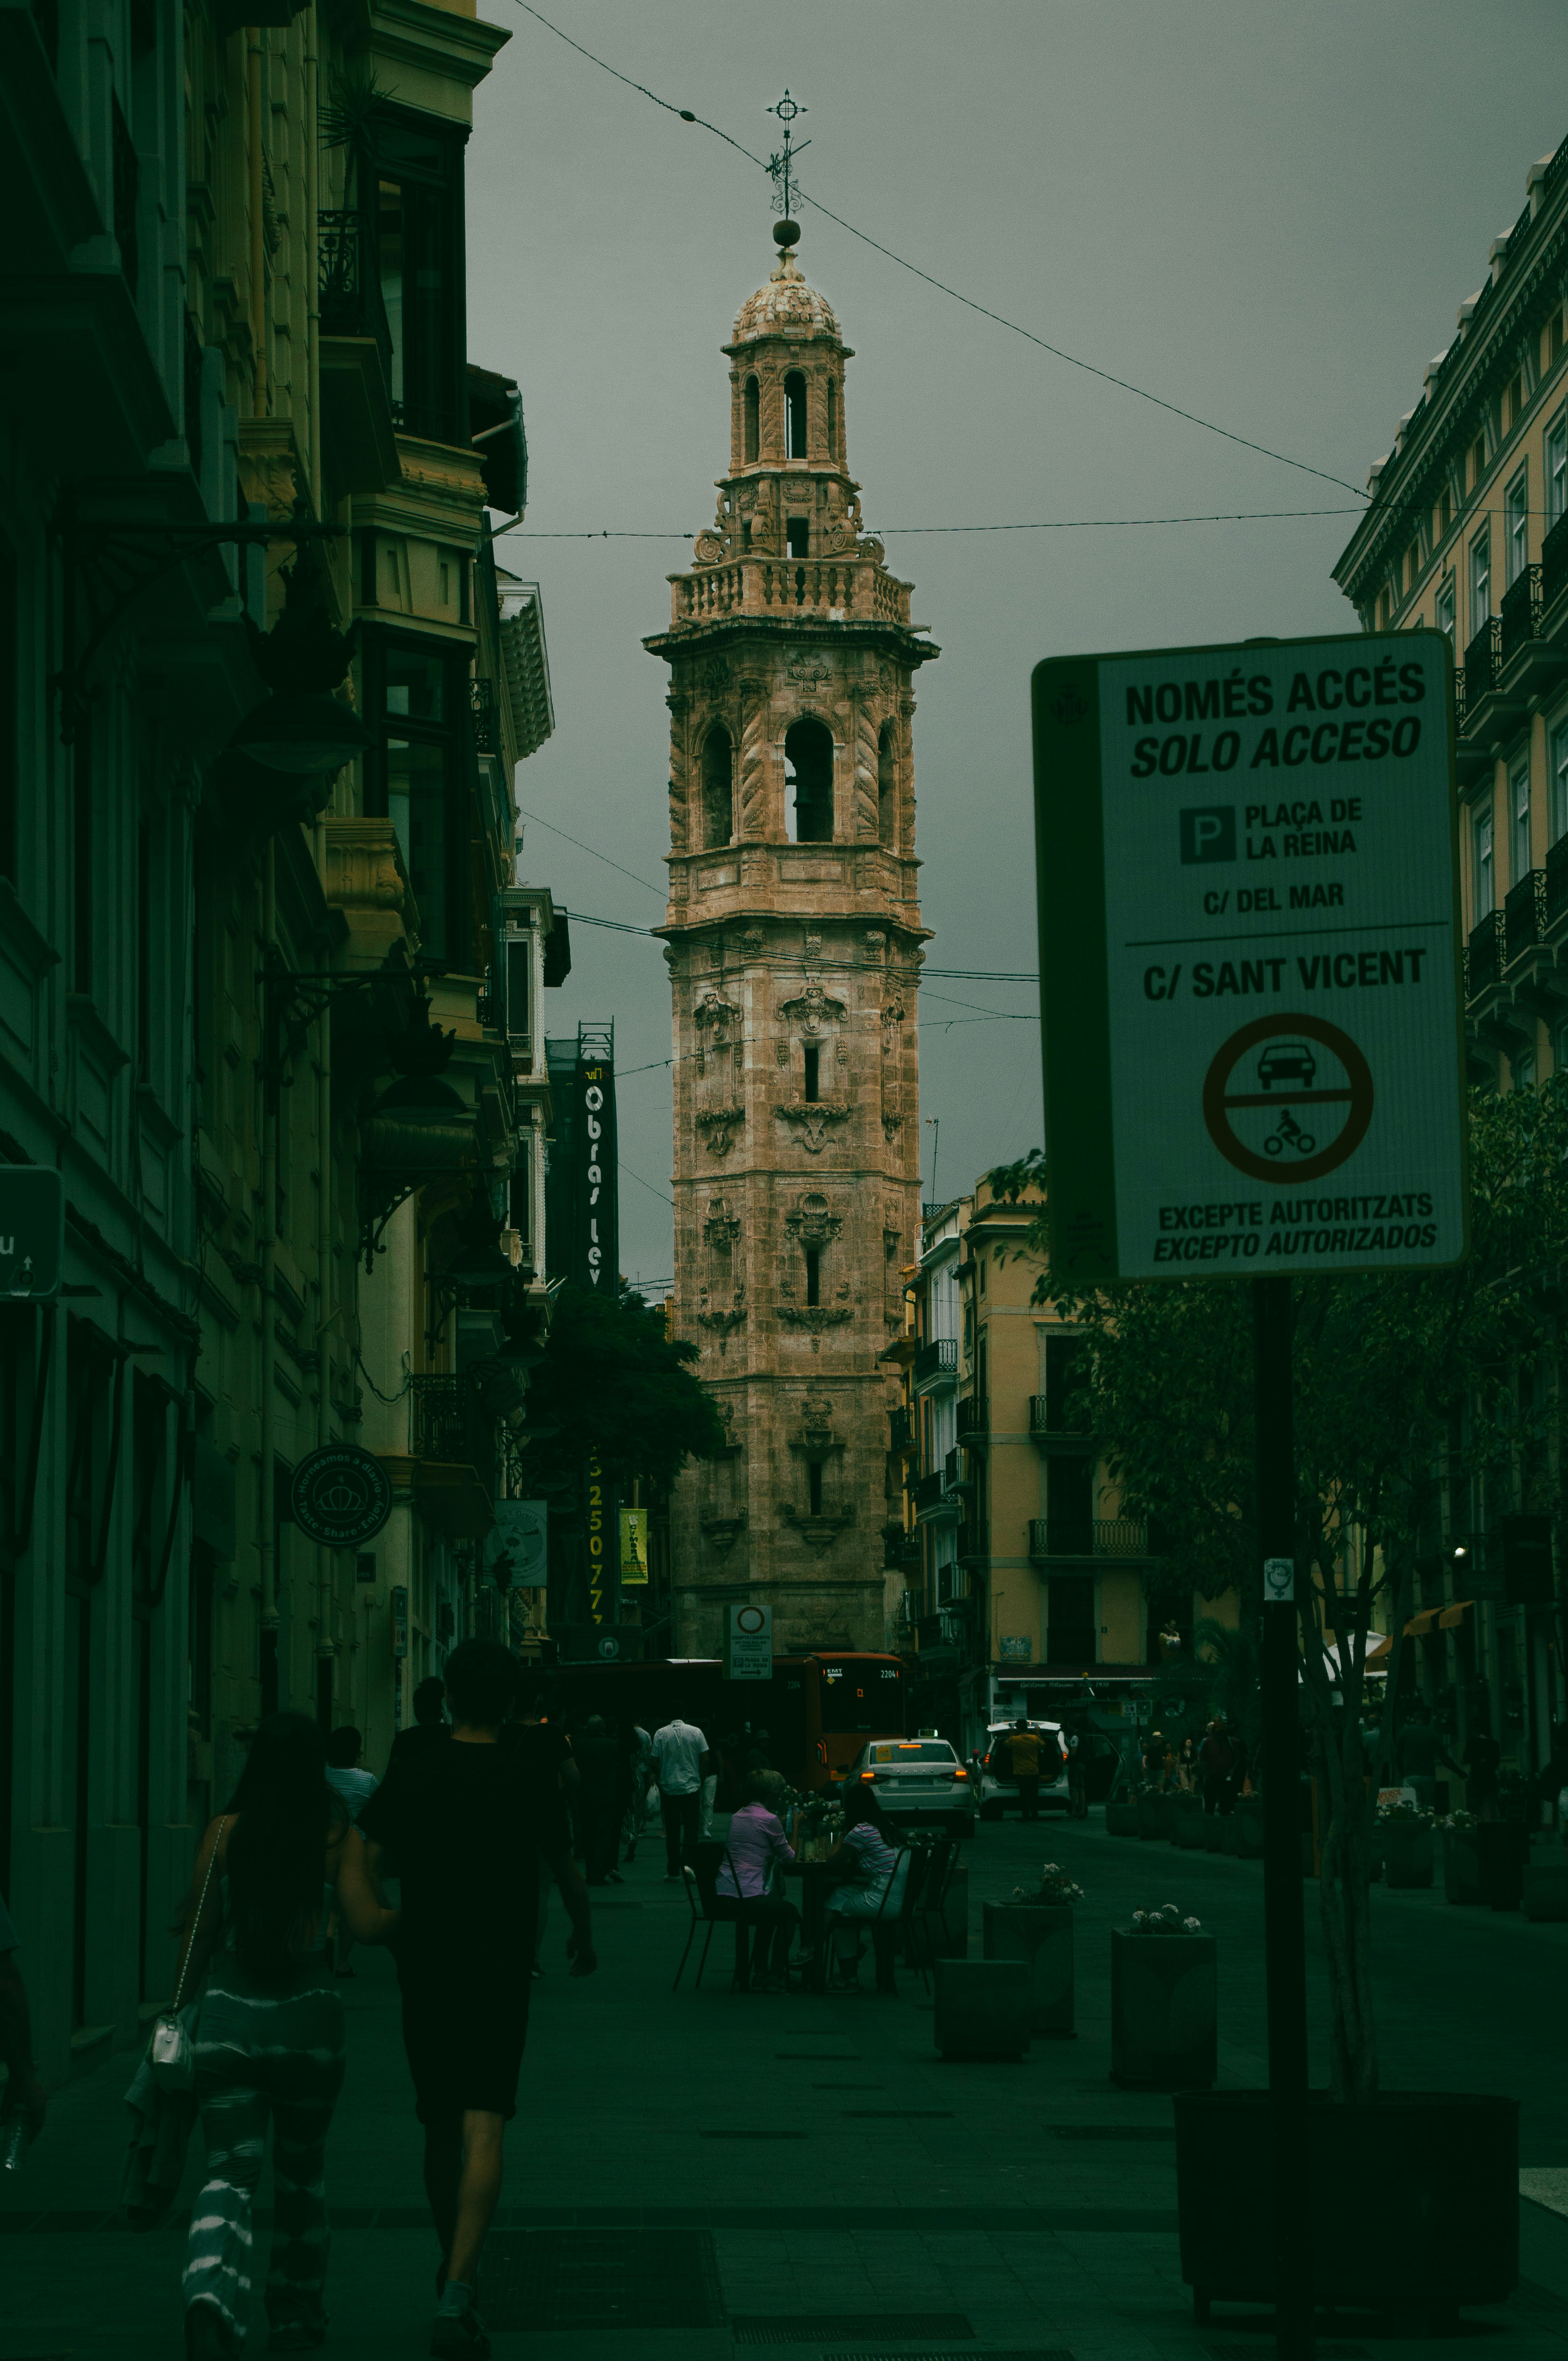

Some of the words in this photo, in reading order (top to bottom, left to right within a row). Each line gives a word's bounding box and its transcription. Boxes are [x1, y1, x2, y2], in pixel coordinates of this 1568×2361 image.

[1126, 669, 1273, 726] NOMÉS
[1287, 656, 1426, 713] ACCÉS
[1130, 731, 1240, 778] SOLO
[1249, 716, 1421, 769] ACCESO
[1245, 801, 1323, 830] PLAÇA
[1330, 798, 1362, 823] DE
[1194, 815, 1223, 857] P
[1246, 835, 1277, 860] LA
[1283, 830, 1357, 856] REINA
[1204, 890, 1229, 914] C/
[1237, 888, 1282, 913] DEL
[1291, 883, 1344, 909] MAR
[1144, 964, 1182, 1000] C/
[1193, 957, 1286, 997] SANT
[1297, 948, 1426, 990] VICENT
[1159, 1201, 1264, 1230] EXCEPTE
[1269, 1193, 1433, 1224] AUTORITZATS
[588, 1218, 602, 1288] lev
[1153, 1232, 1260, 1262] EXCEPTO
[1266, 1224, 1437, 1256] AUTORIZADOS
[298, 1454, 350, 1493] Horneamos
[362, 1463, 383, 1493] diario
[299, 1501, 318, 1529] Taste
[324, 1527, 357, 1538] Share
[362, 1500, 384, 1529] Enjoy
[516, 1510, 538, 1523] Gracia
[788, 1681, 801, 1689] 2204
[880, 1670, 896, 1678] 2204
